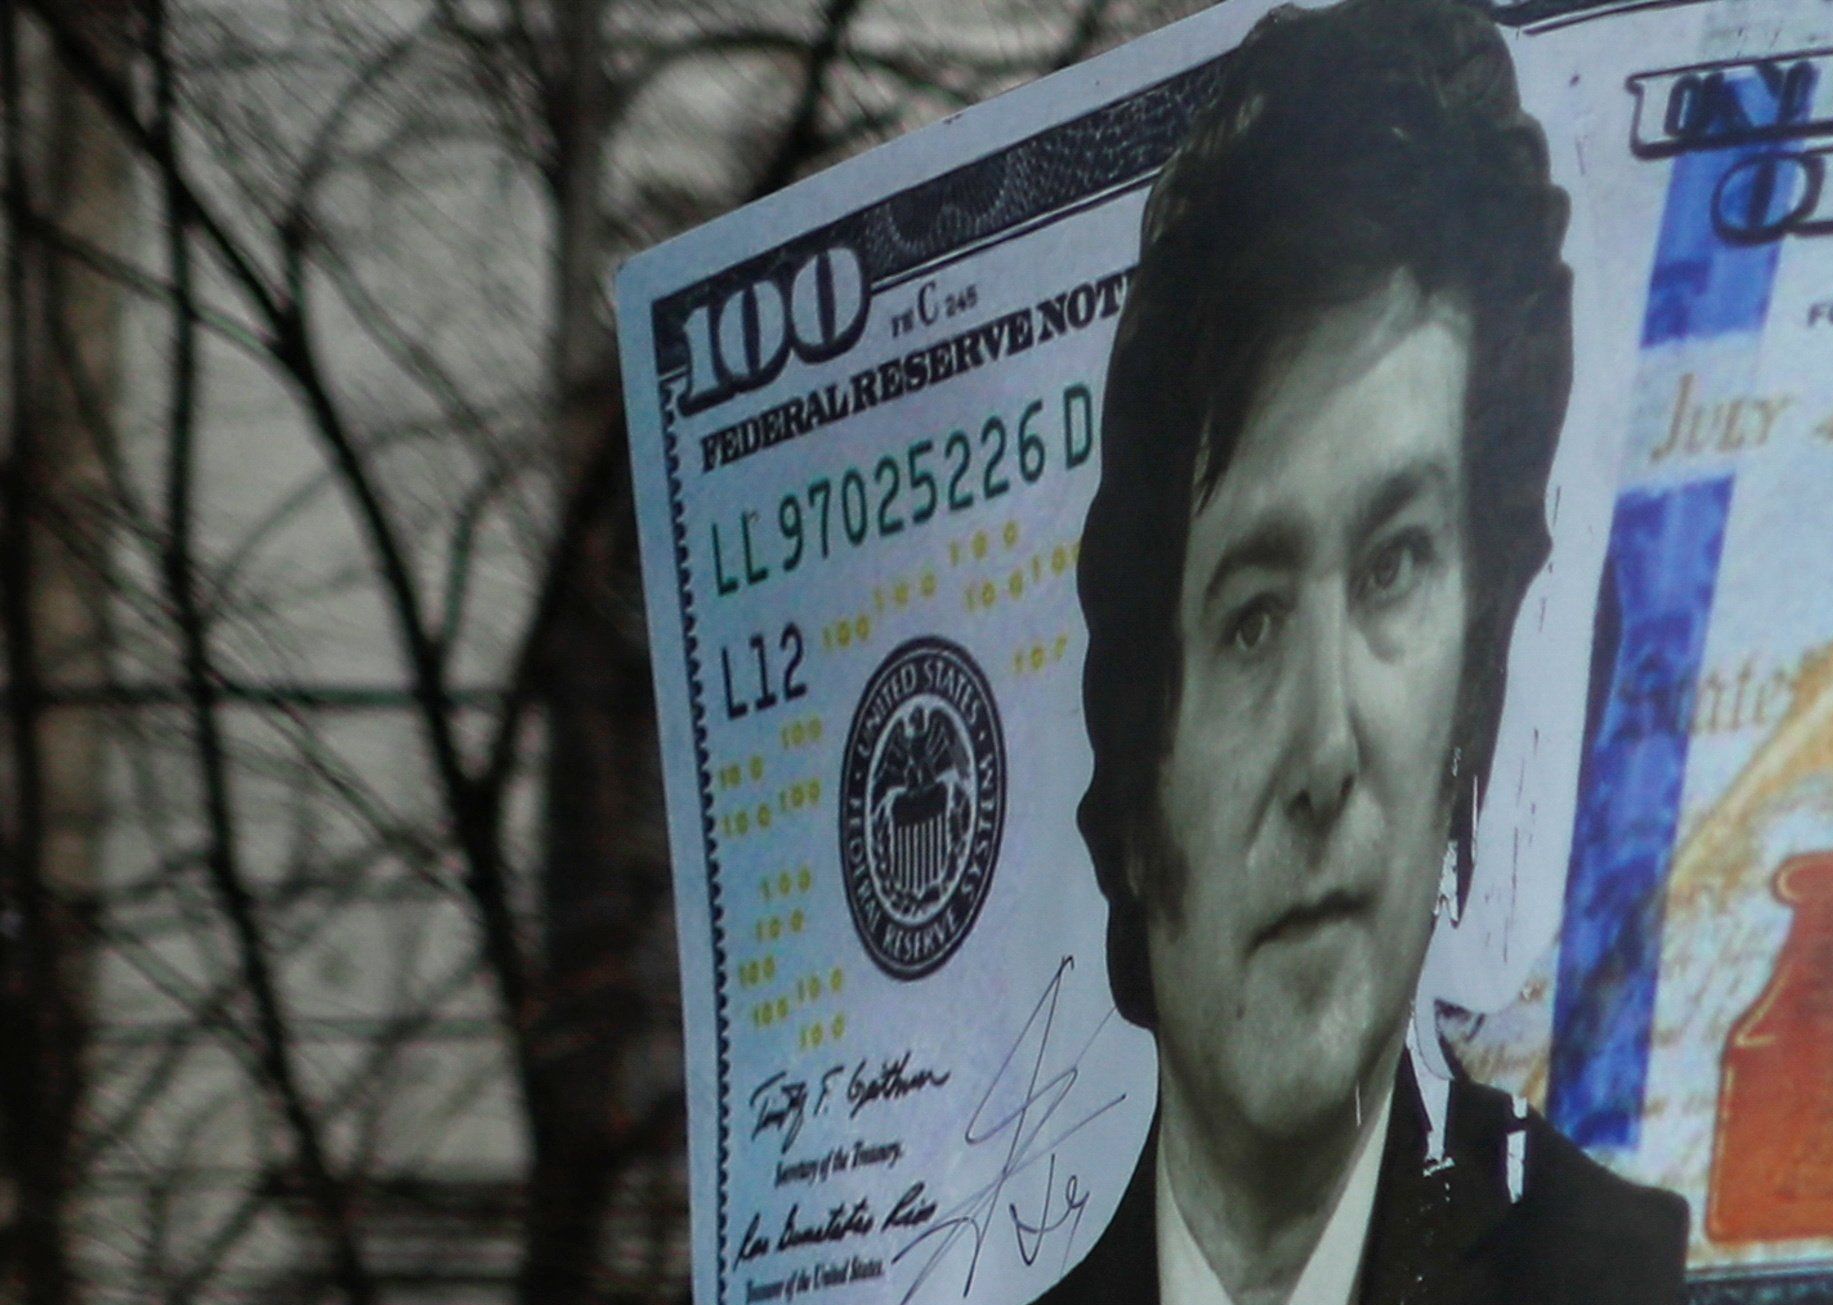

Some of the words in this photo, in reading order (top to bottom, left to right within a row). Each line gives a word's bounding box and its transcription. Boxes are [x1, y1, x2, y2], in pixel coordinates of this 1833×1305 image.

[678, 246, 873, 418] 100
[700, 383, 853, 473] FEDERAL
[850, 309, 1035, 414] RESERVE
[1037, 267, 1134, 343] NOT
[1648, 372, 1791, 466] JULY
[721, 621, 808, 722] L12
